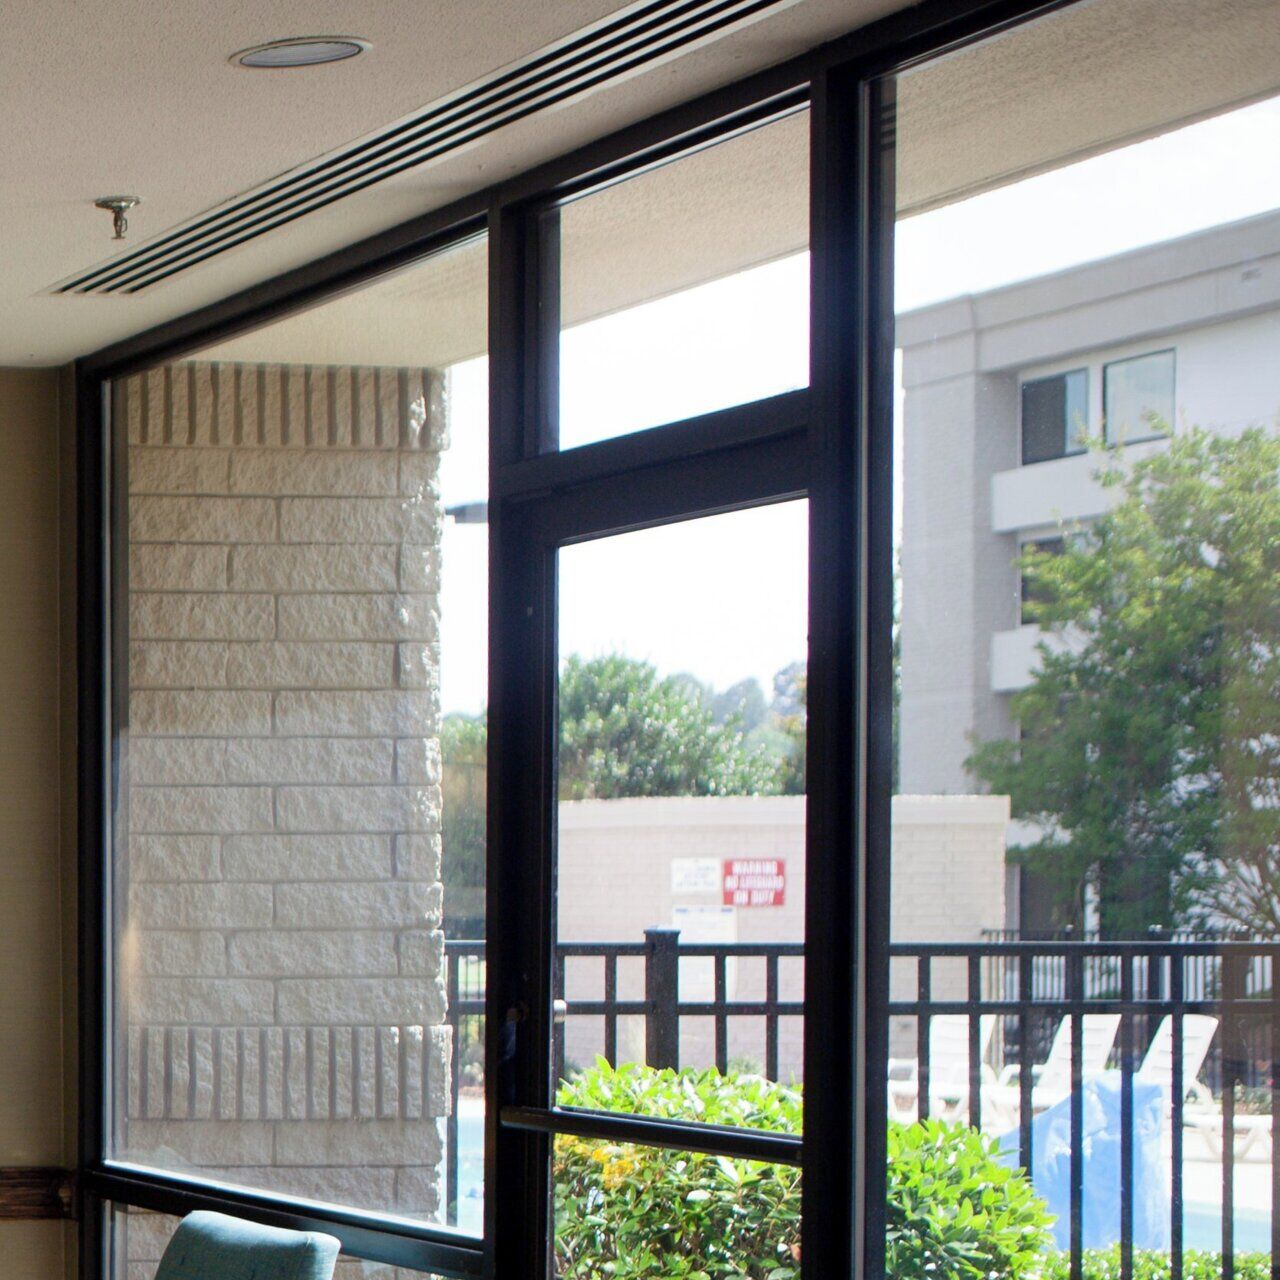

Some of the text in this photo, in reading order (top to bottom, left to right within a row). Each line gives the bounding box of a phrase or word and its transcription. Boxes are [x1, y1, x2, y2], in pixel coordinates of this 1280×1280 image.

[732, 860, 778, 874] WARNING
[725, 875, 739, 888] NO
[740, 875, 785, 888] LIFEGUARD
[734, 890, 776, 903] ON DUTY
